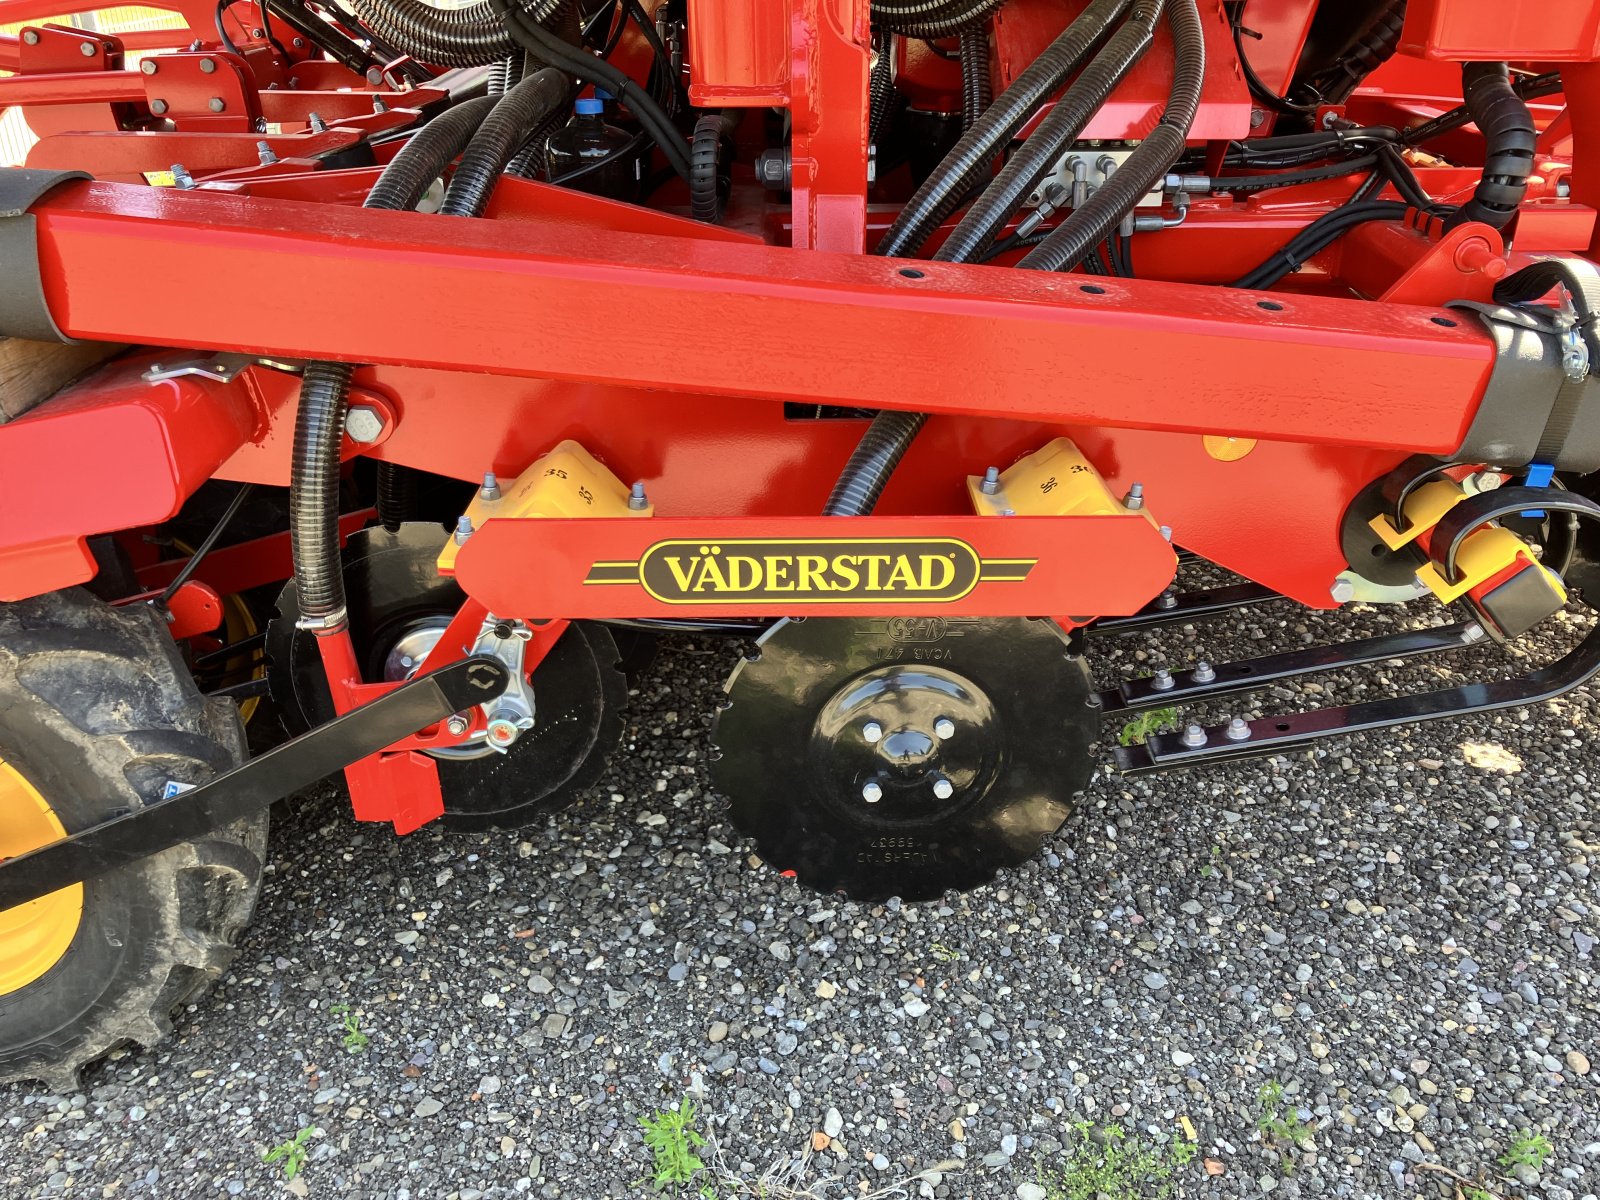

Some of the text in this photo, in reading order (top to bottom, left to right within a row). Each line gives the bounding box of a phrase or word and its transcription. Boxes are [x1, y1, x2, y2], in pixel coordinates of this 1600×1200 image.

[544, 468, 568, 480] 35
[578, 485, 594, 505] 35
[1040, 476, 1058, 494] 36
[663, 545, 956, 592] VÄDERSTAD
[893, 618, 937, 639] V-55
